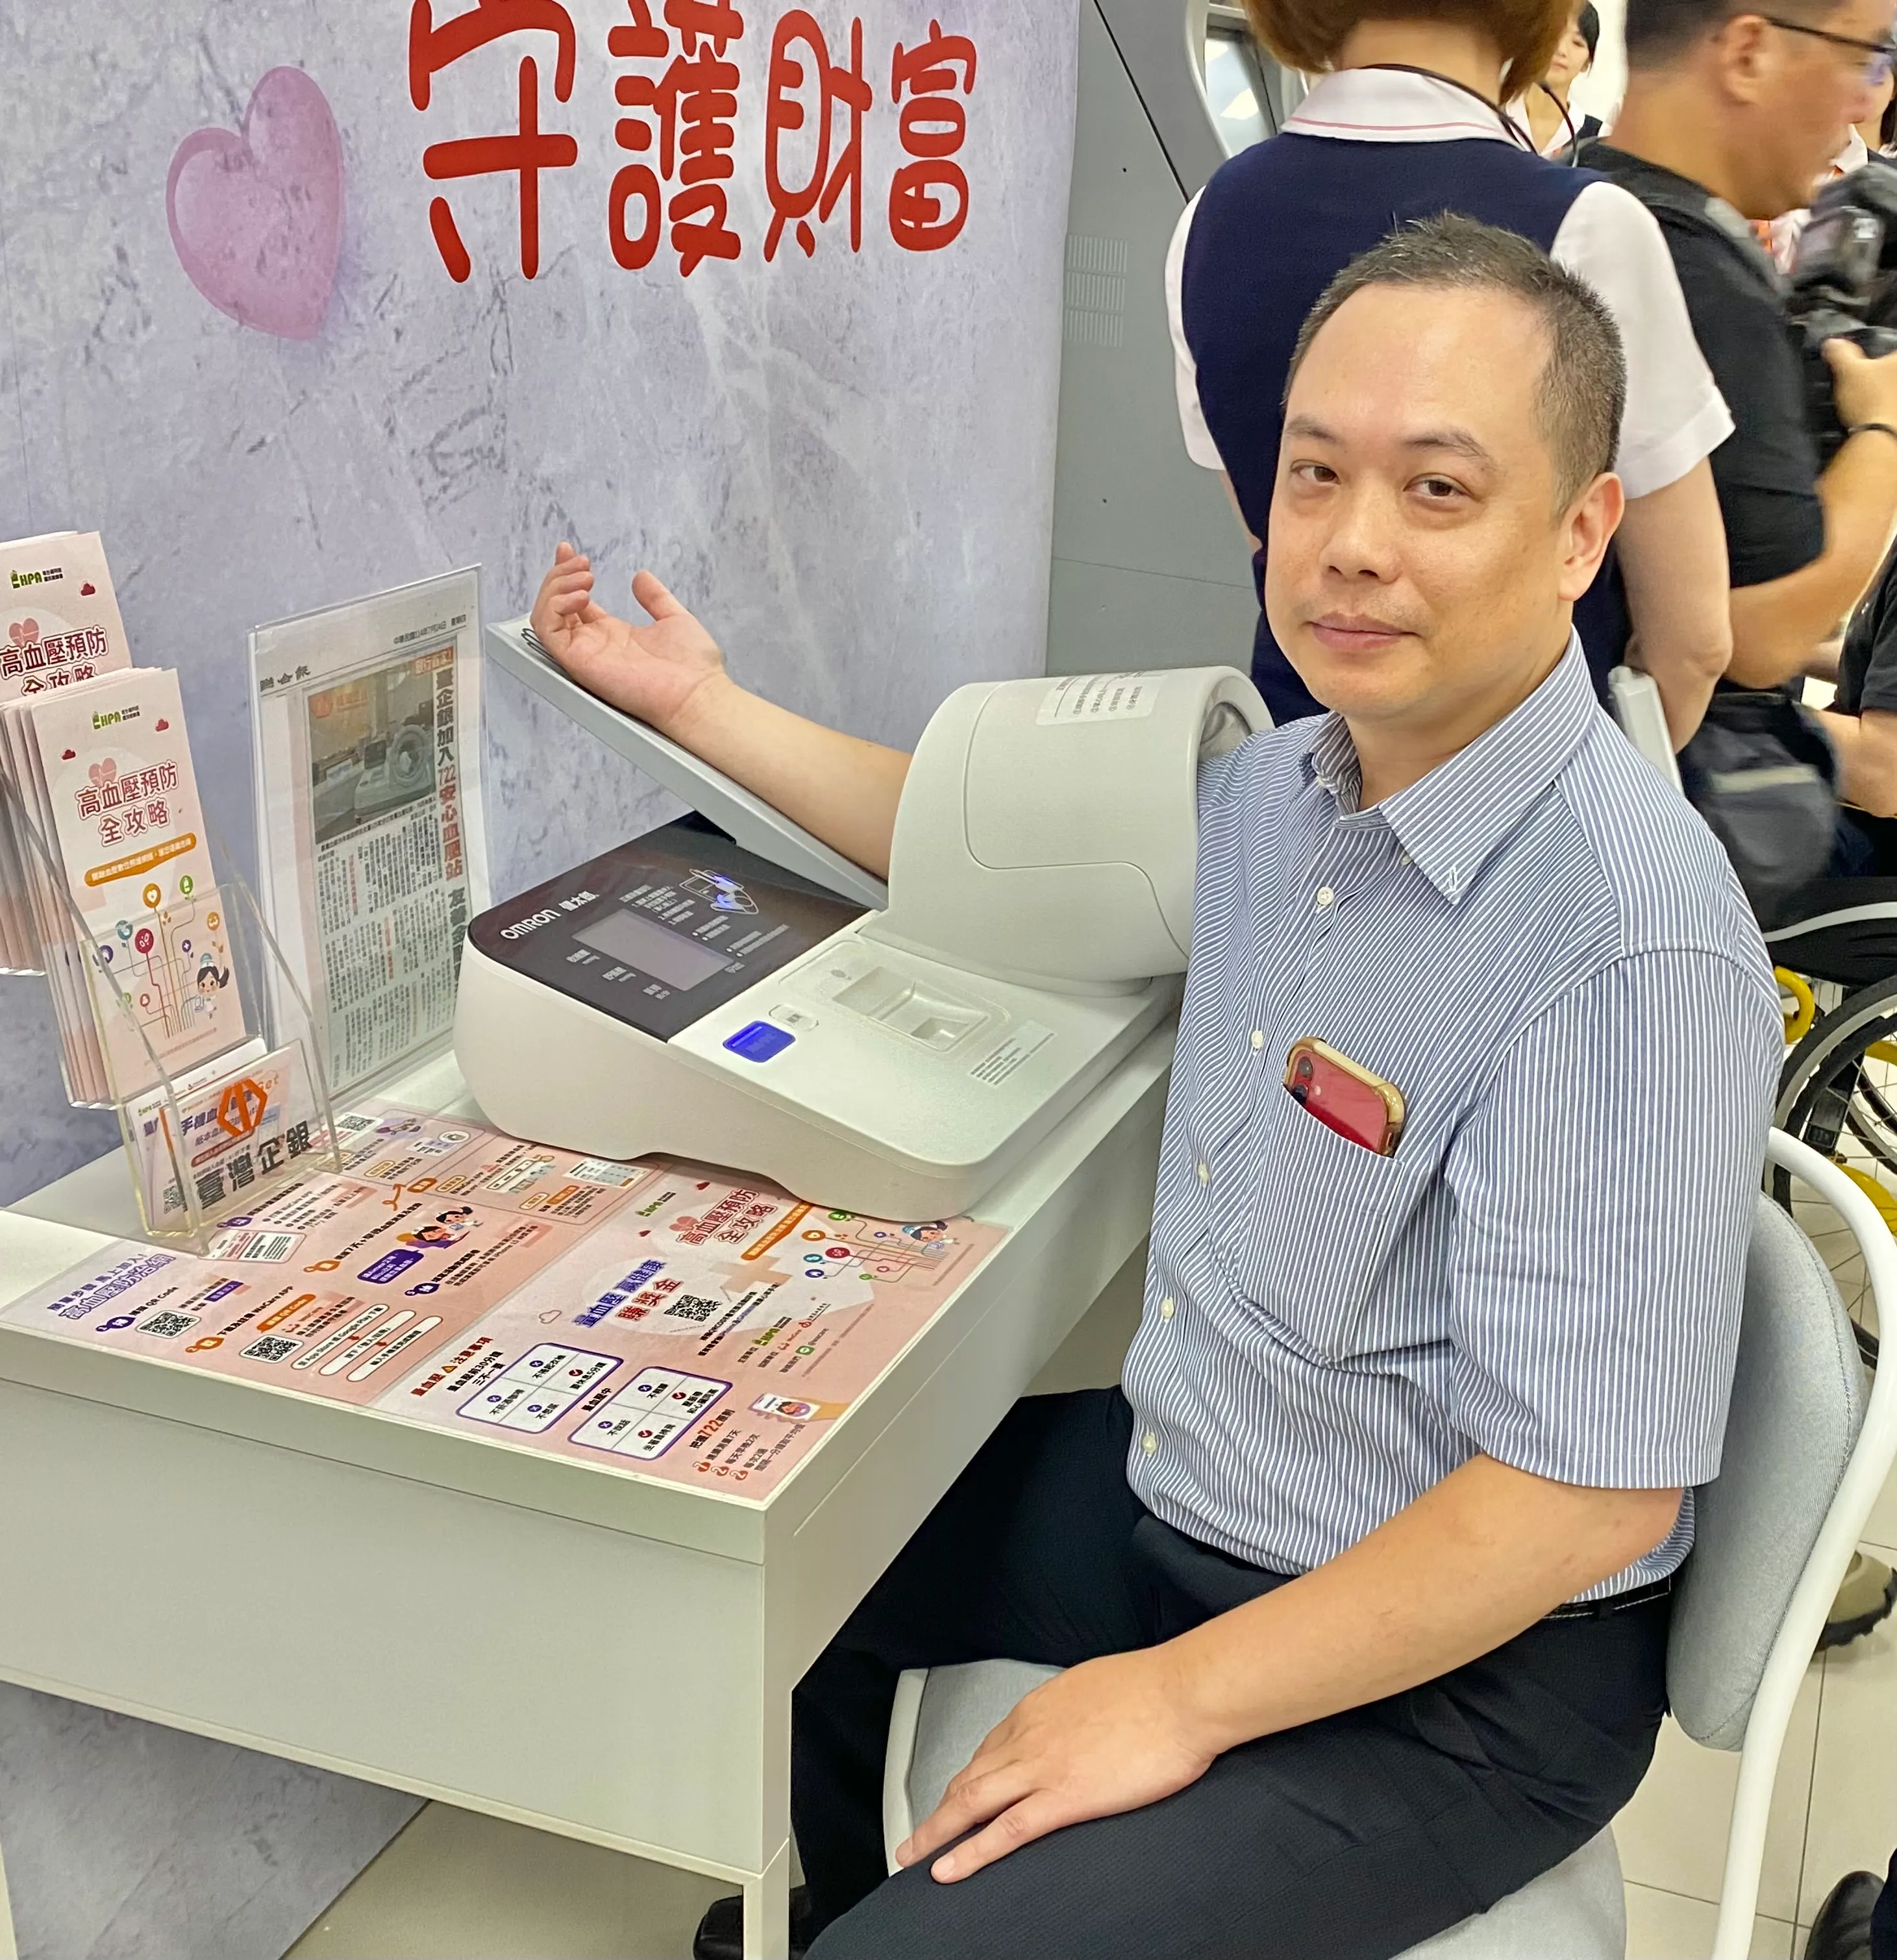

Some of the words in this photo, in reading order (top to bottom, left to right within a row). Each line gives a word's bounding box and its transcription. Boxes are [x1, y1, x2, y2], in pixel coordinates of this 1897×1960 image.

[409, 0, 976, 282] 守護財富
[0, 626, 107, 678] 高血壓預防
[101, 711, 122, 727] HPA
[77, 762, 178, 818] 高血壓預防
[100, 799, 169, 845] 全攻略
[500, 909, 561, 941] OMRON
[196, 1120, 313, 1209] 臺灣企銀
[680, 1187, 758, 1244] 高血壓預防
[717, 1204, 774, 1243] 全攻略
[94, 1253, 146, 1283] 馬上加入!
[492, 1244, 513, 1258] iPhone
[58, 1253, 175, 1319] 高血壓防治網
[145, 1298, 160, 1306] QR
[156, 1286, 179, 1299] Code
[251, 1295, 281, 1313] WaCare
[278, 1285, 293, 1296] APP
[288, 1298, 307, 1310] Code
[574, 1293, 626, 1327] 量血壓
[614, 1259, 665, 1293] 贏健康
[617, 1278, 681, 1321] 賺獎金
[304, 1352, 319, 1361] App
[316, 1341, 334, 1353] Store
[337, 1322, 360, 1337] Google
[355, 1315, 373, 1324] Play
[760, 1328, 780, 1341] HPA
[410, 1372, 446, 1396] 量血壓
[450, 1336, 493, 1365] 注意事項
[447, 1350, 503, 1391] 量血壓前30分鐘
[471, 1362, 505, 1386] 三不一要
[581, 1387, 612, 1411] 量血壓中
[689, 1408, 735, 1448] 把握722原則
